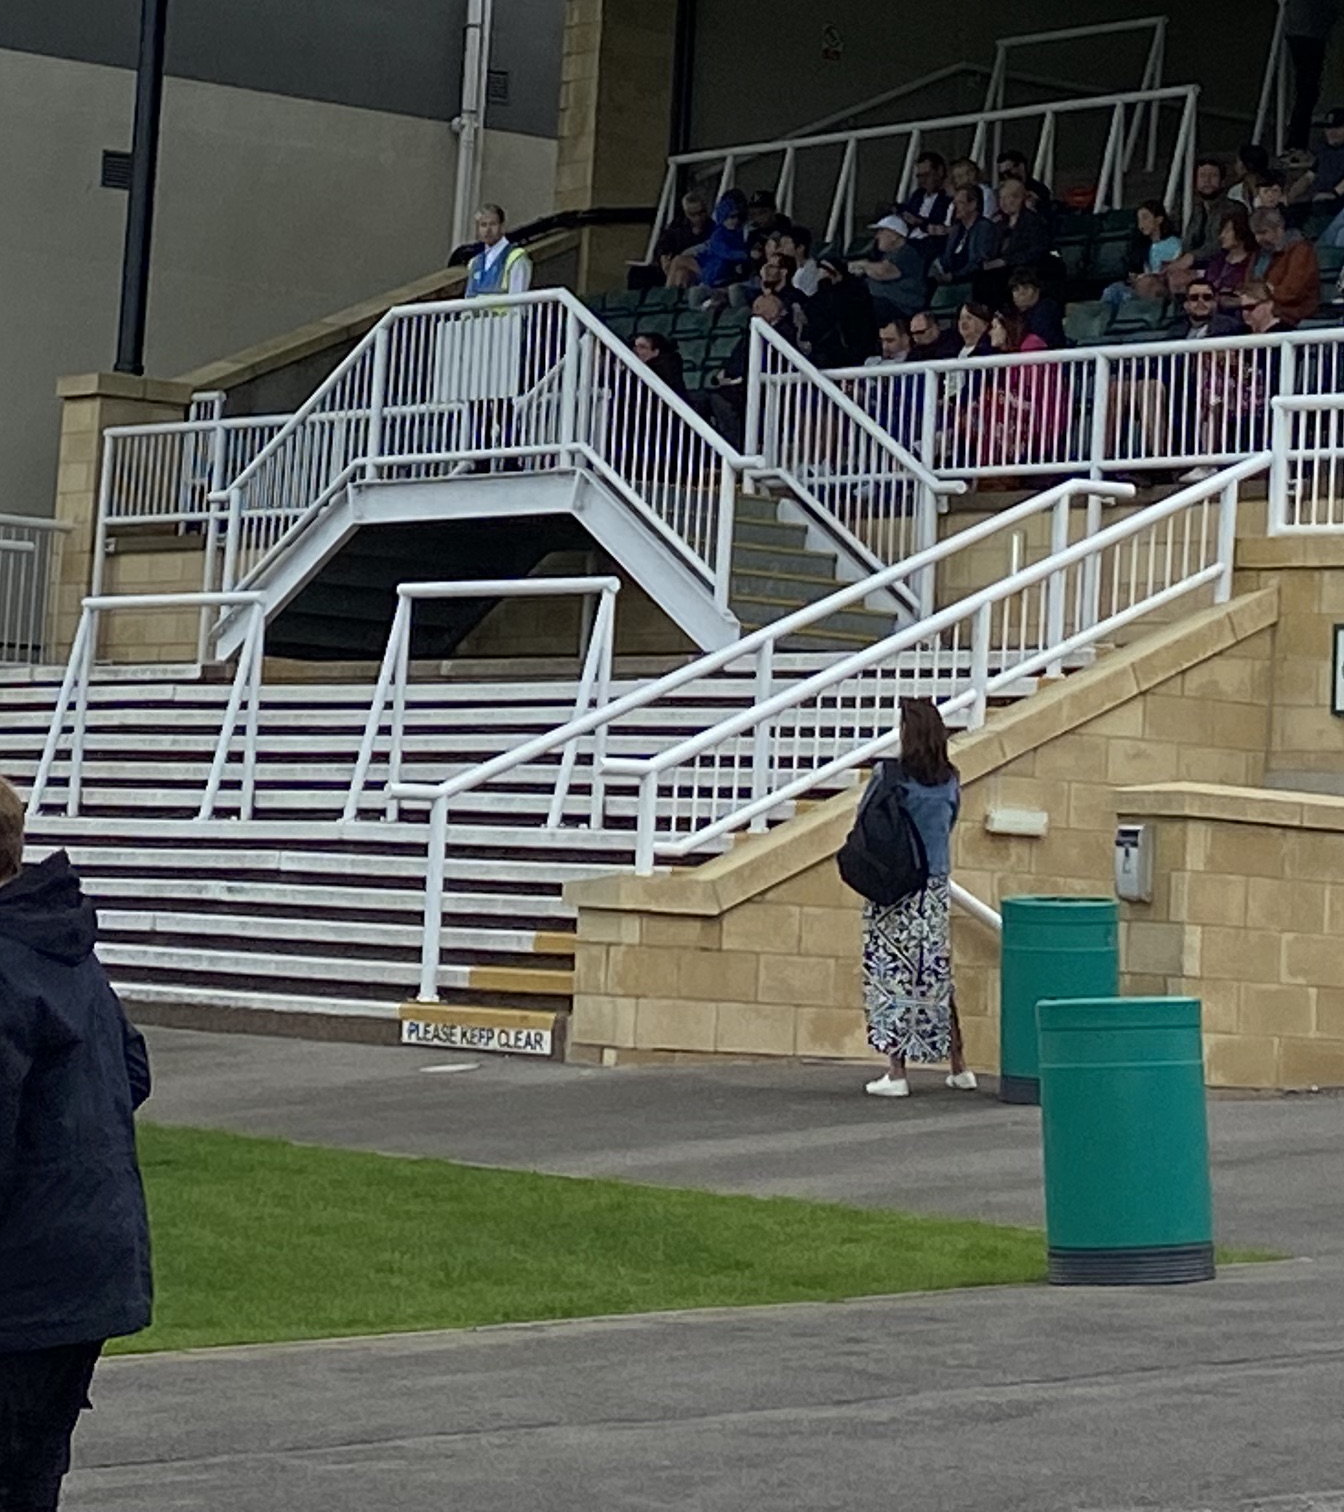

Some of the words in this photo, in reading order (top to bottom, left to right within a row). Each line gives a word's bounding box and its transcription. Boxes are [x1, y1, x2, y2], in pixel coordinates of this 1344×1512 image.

[407, 1021, 458, 1045] PLEASE
[460, 1026, 495, 1047] KEEP
[497, 1028, 544, 1051] CLEAR
